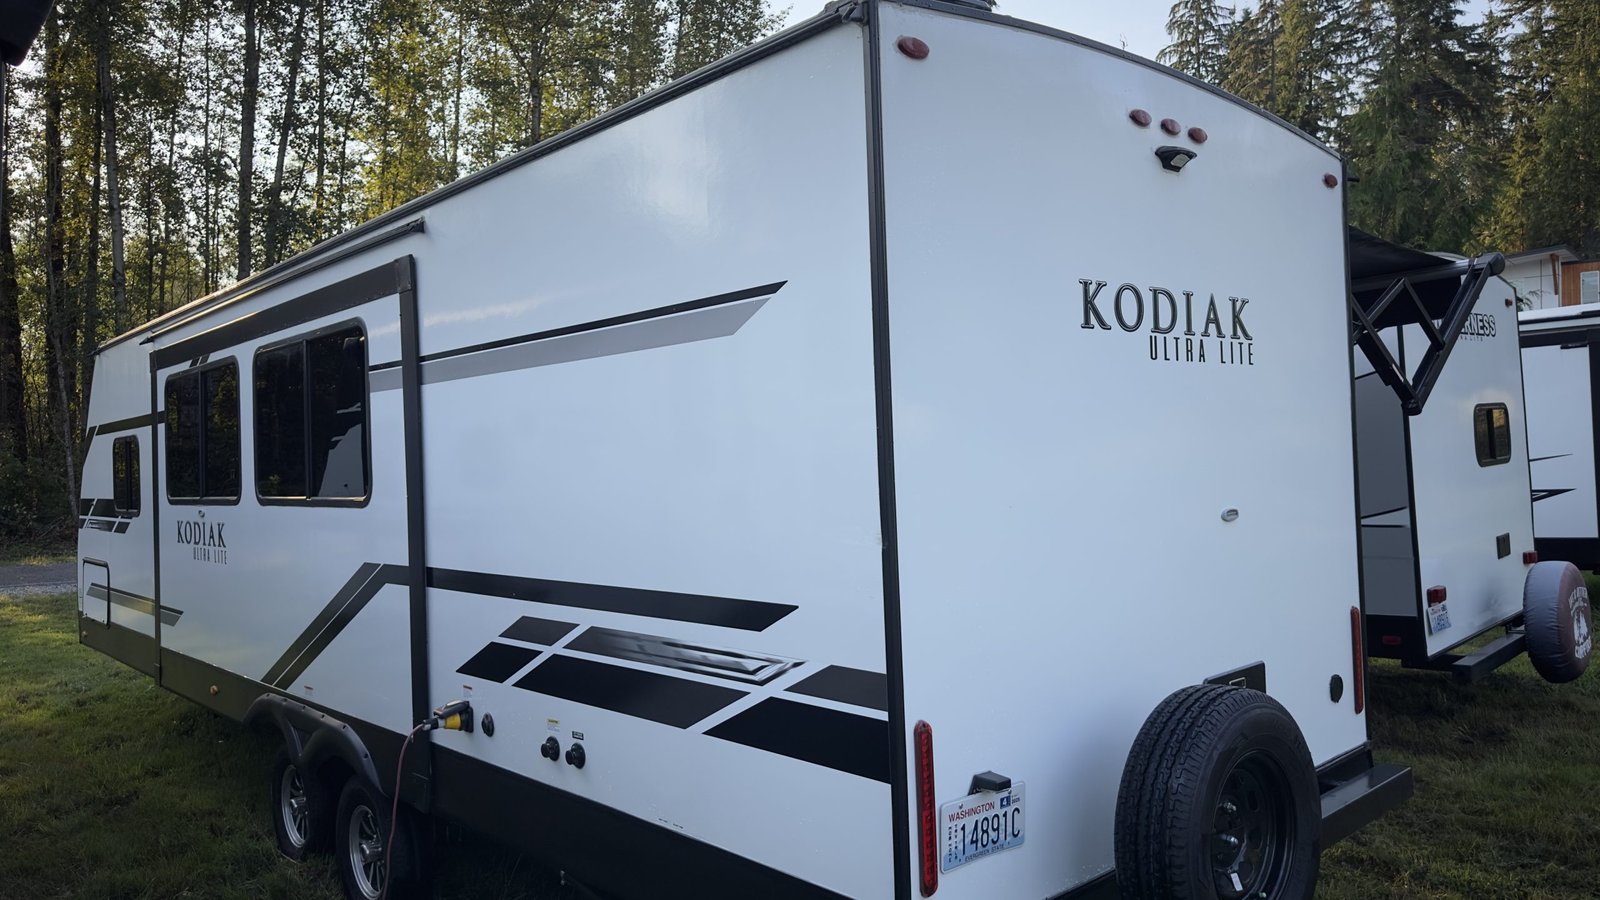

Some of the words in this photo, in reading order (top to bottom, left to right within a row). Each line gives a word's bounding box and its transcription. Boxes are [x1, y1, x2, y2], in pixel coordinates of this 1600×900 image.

[1078, 278, 1253, 341] KODIAK
[1460, 312, 1496, 337] RNESS
[1149, 335, 1206, 363] ULTRA
[1219, 340, 1254, 365] LITE
[177, 520, 227, 548] KODIAK
[948, 801, 995, 823] WASHINGTON
[960, 807, 1021, 856] 14891C
